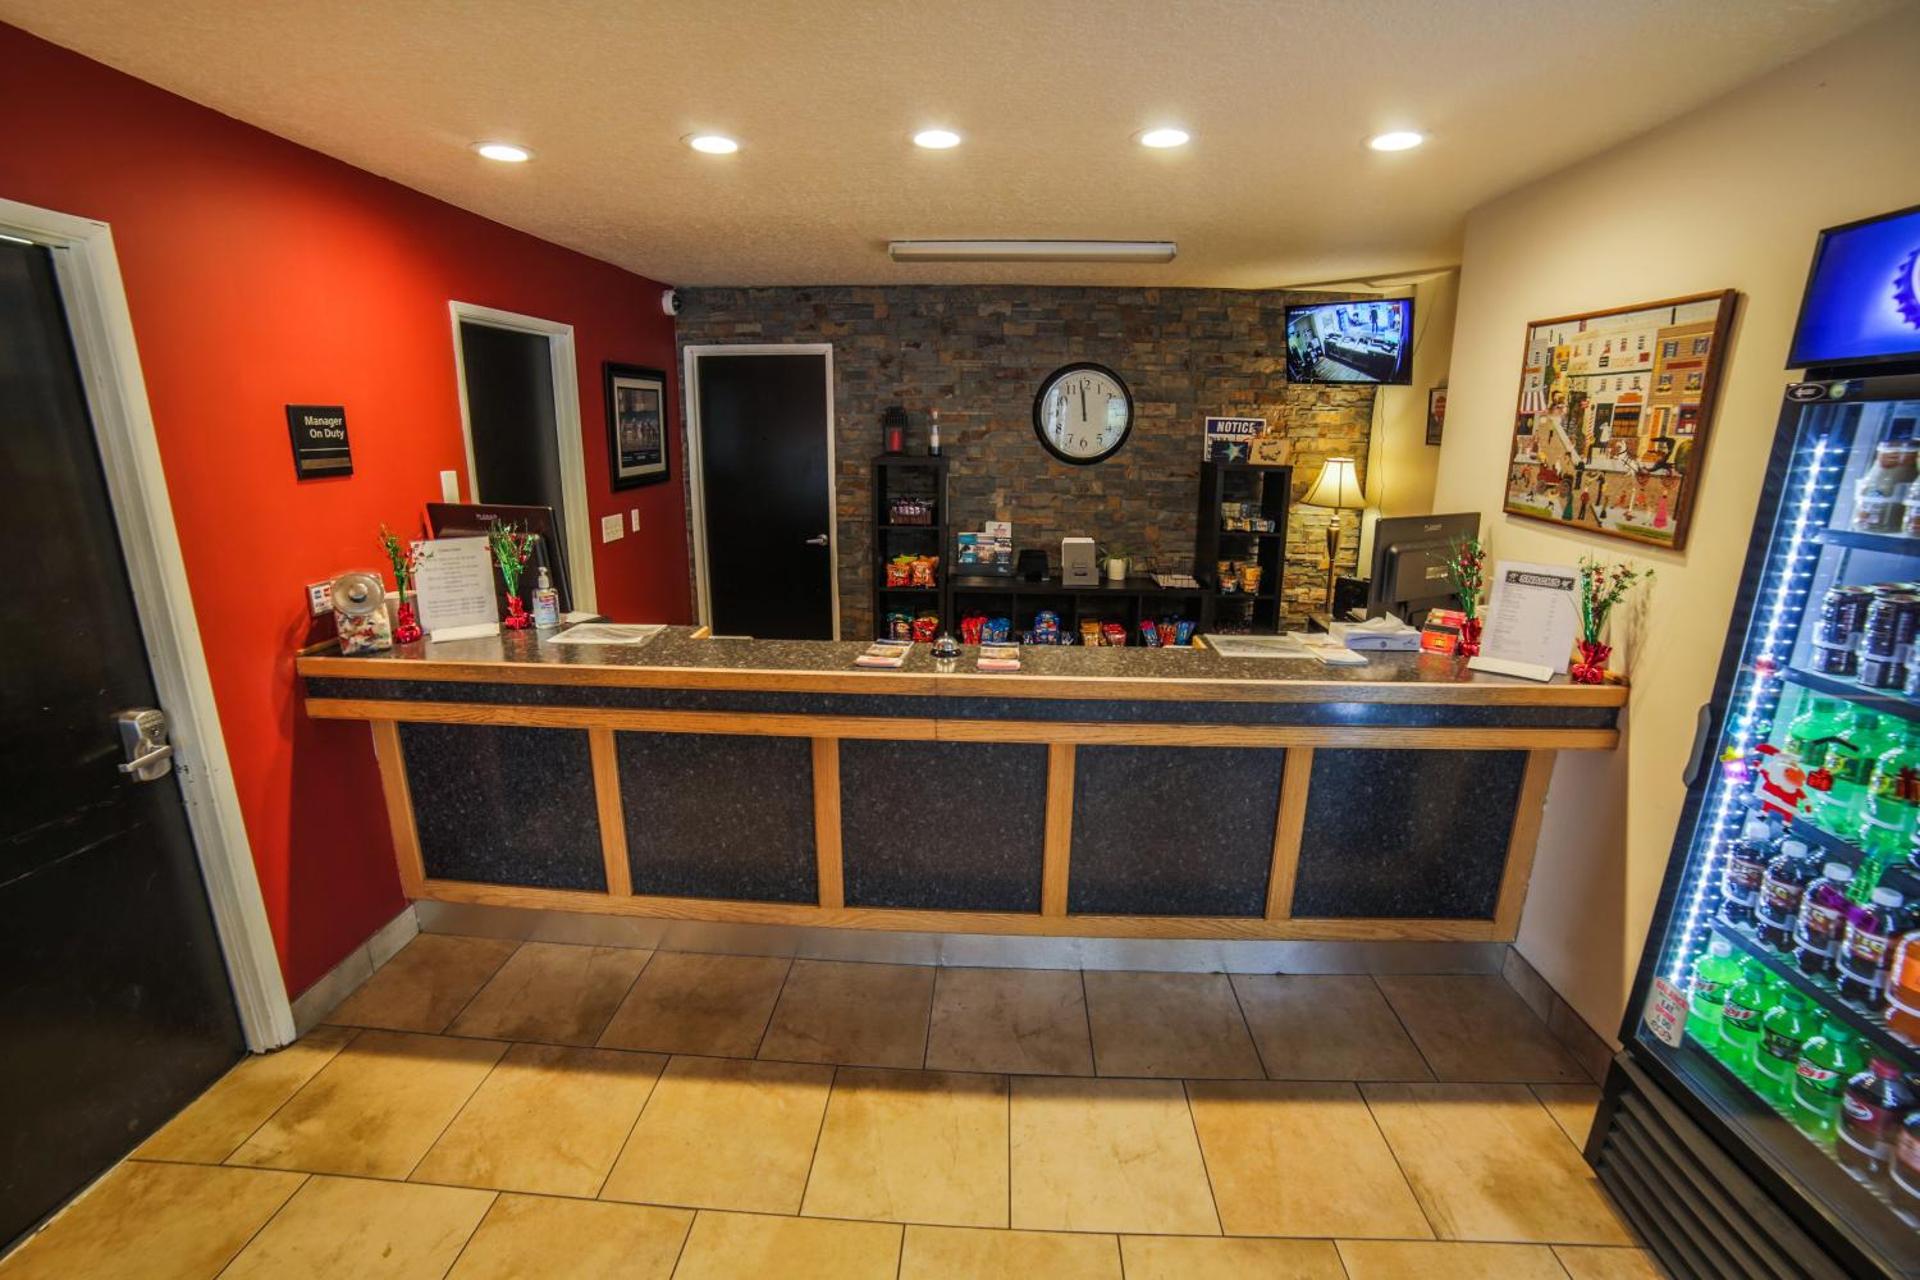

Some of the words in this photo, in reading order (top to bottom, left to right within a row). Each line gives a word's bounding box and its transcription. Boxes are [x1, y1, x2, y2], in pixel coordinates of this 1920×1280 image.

[304, 415, 343, 428] Manager
[1216, 421, 1257, 434] NOTICE
[309, 428, 323, 439] On
[324, 428, 345, 440] Duty
